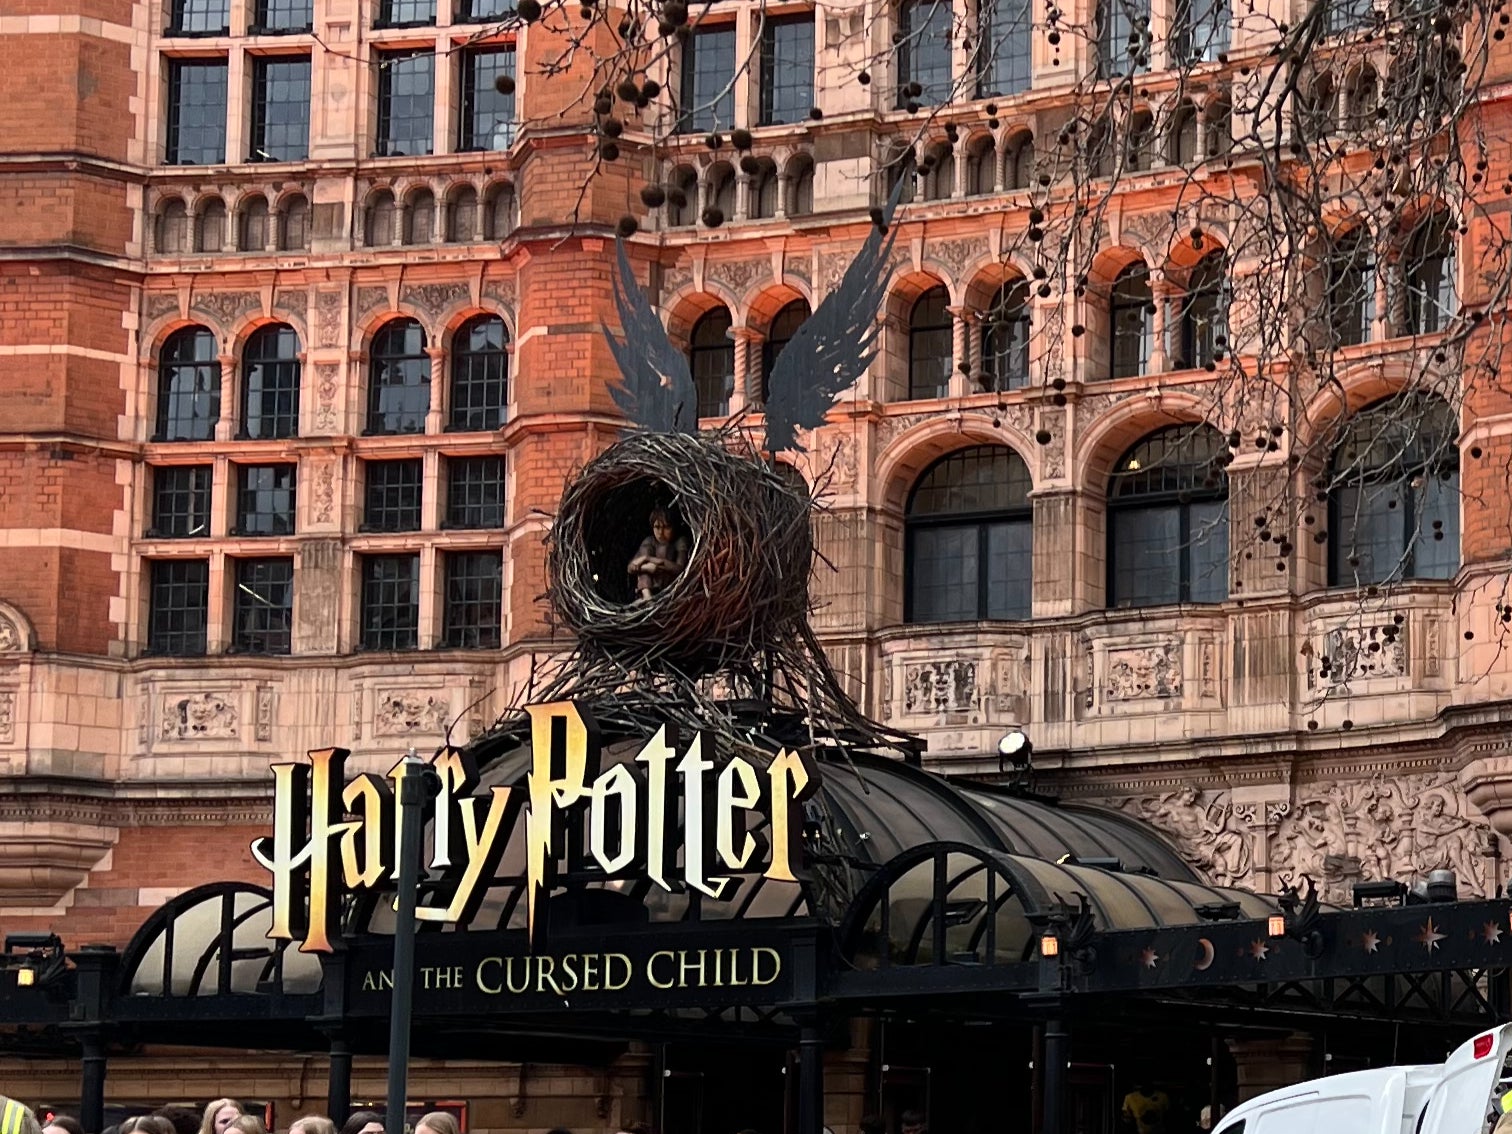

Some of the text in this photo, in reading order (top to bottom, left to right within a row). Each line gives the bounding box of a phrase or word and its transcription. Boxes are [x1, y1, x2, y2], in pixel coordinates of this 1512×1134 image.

[524, 701, 809, 952] Potter
[362, 947, 781, 996] AN THE CURSED CHILD
